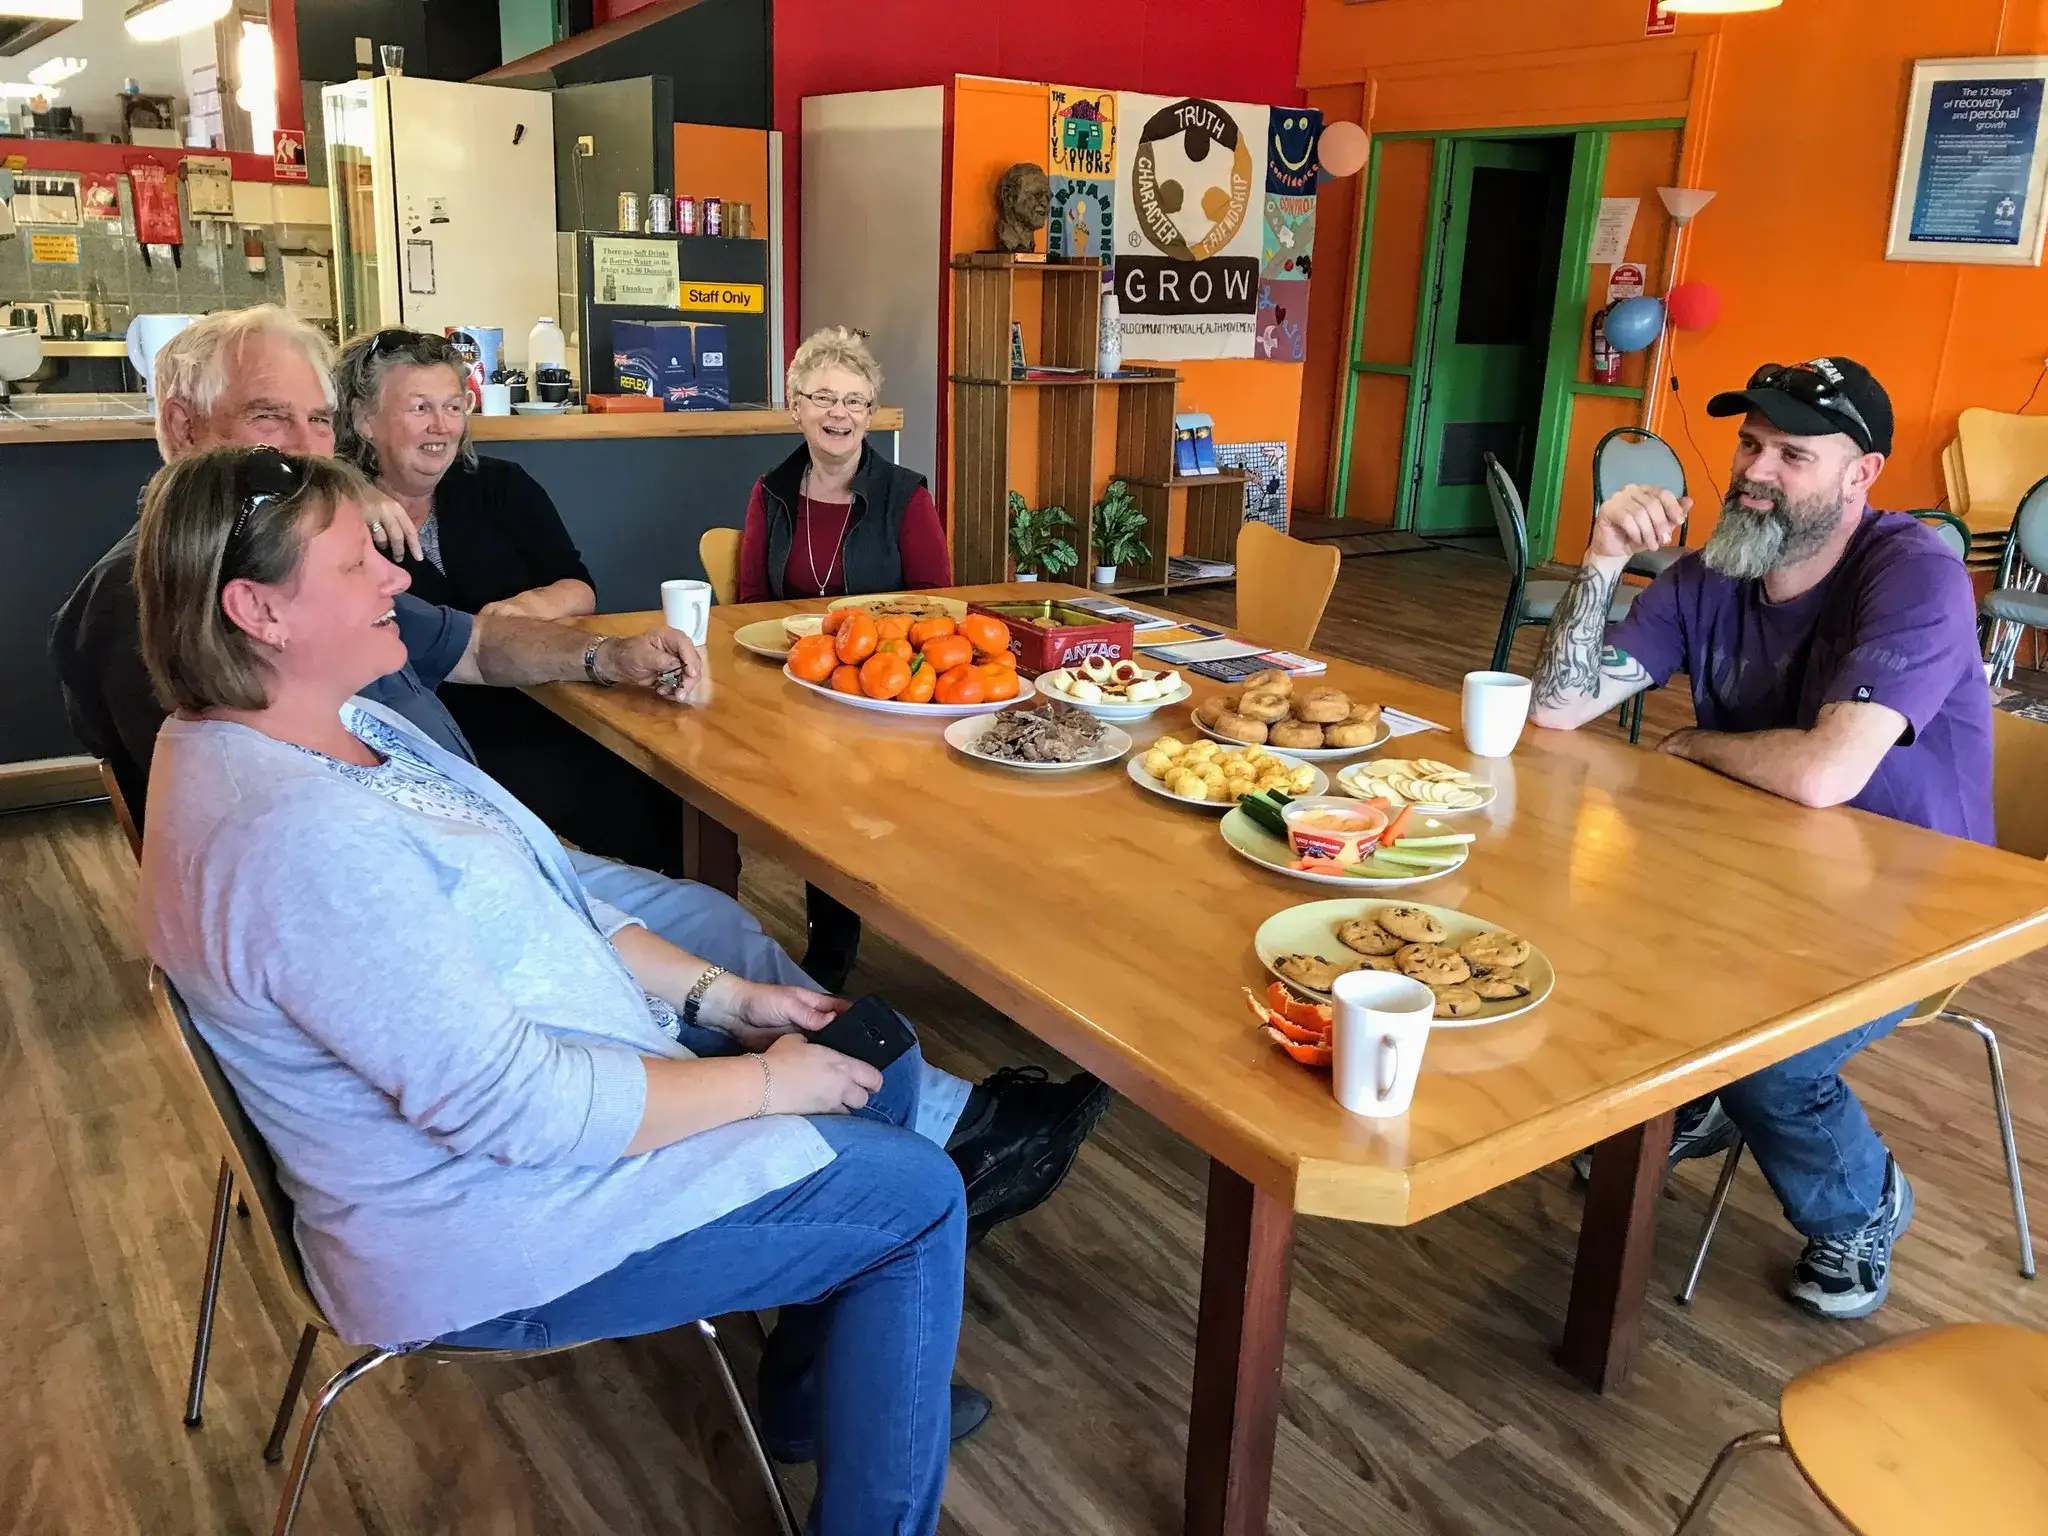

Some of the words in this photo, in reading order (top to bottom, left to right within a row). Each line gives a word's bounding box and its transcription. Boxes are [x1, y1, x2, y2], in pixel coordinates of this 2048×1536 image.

[1051, 90, 1066, 104] THE
[1962, 87, 1978, 96] The
[1980, 87, 1989, 96] 12
[1990, 87, 2013, 97] Steps
[1943, 99, 1953, 109] of
[1954, 98, 2004, 110] recovery
[1952, 110, 1968, 120] and
[1969, 107, 2021, 122] personal
[1174, 105, 1225, 139] TRUTH
[1976, 119, 2007, 131] growth
[1110, 125, 1117, 145] OF
[1138, 156, 1178, 246] CHARACTER
[1202, 173, 1248, 254] FRIENDSHIP
[603, 247, 621, 255] There
[648, 249, 670, 257] Drinks
[601, 256, 607, 264] &
[633, 258, 652, 266] Water
[601, 266, 619, 274] fridge
[644, 267, 673, 276] Donation
[1124, 267, 1250, 304] GROW
[689, 289, 720, 303] Staff
[722, 290, 751, 307] Only
[1119, 323, 1135, 335] RLD
[620, 375, 648, 392] REFLEX
[1061, 643, 1121, 665] ANZAC
[1308, 840, 1340, 851] capsicum
